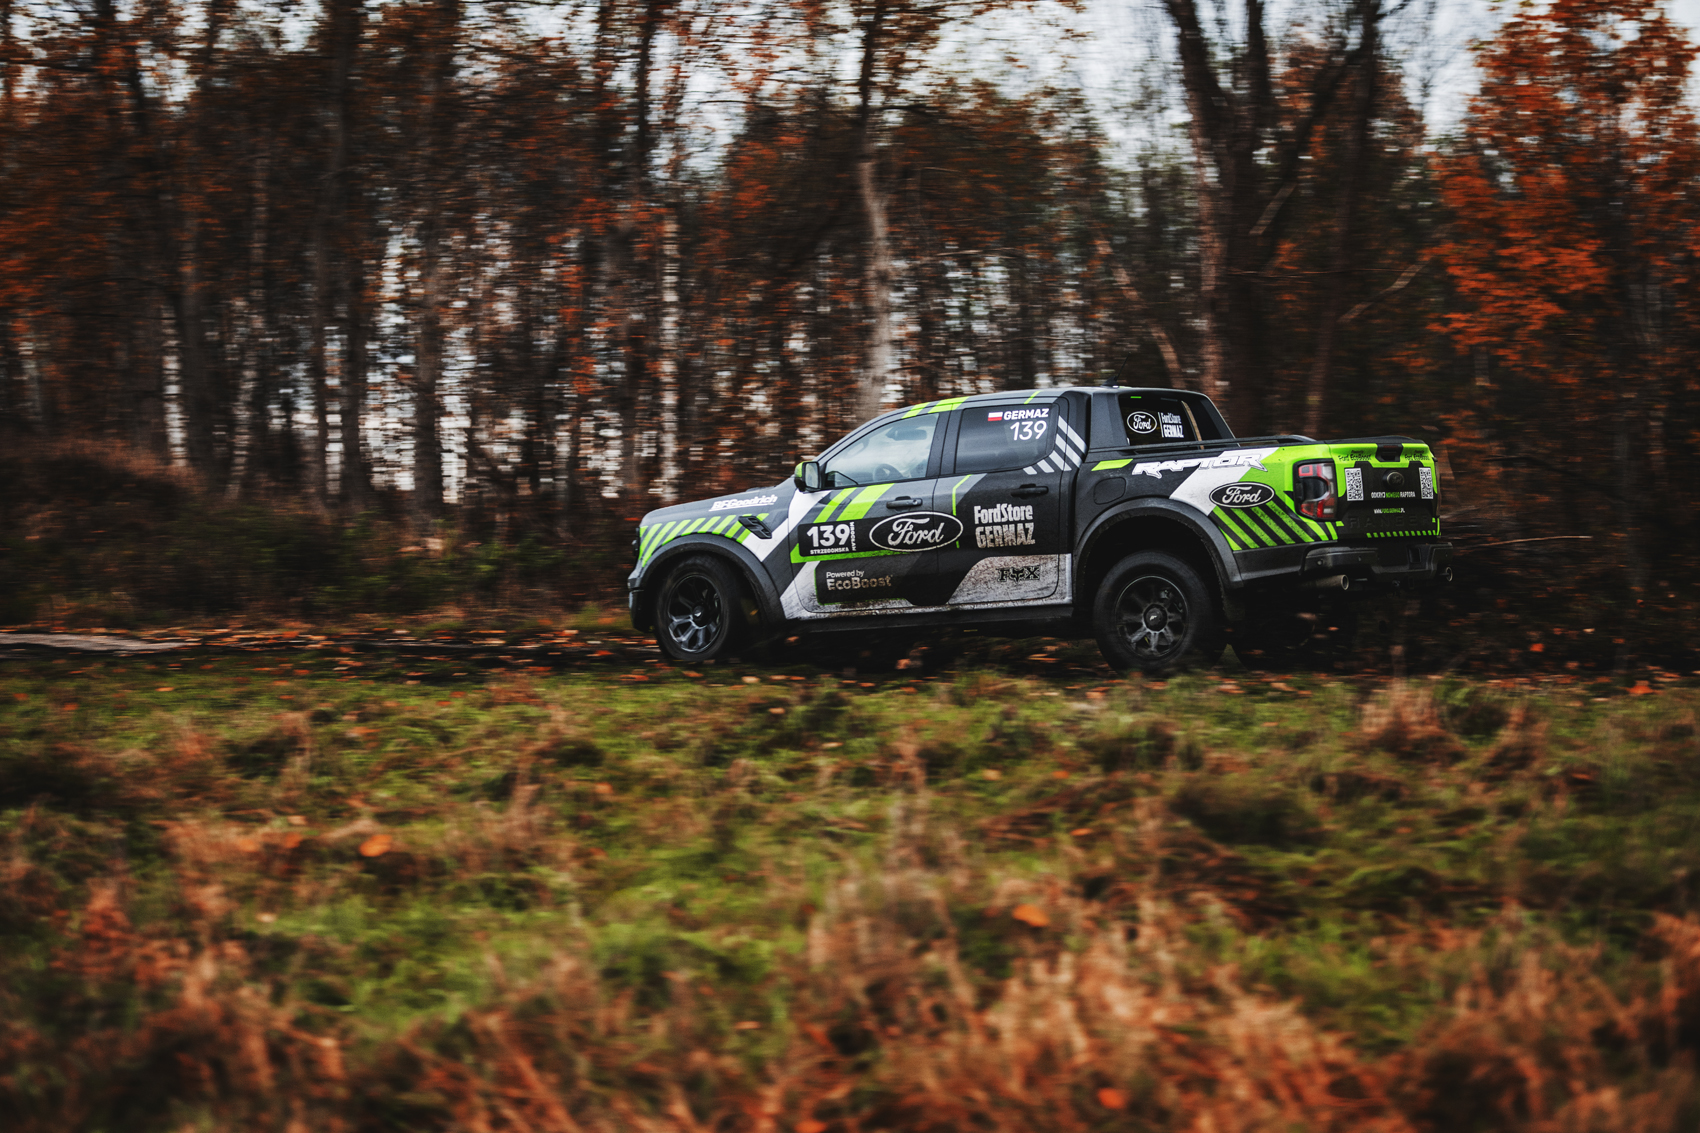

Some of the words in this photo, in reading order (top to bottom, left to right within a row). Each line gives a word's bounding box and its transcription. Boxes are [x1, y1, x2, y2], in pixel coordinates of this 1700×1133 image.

[1003, 408, 1050, 421] GERMAZ
[1133, 414, 1152, 430] Ford
[1010, 420, 1047, 441] 139
[1131, 454, 1268, 479] RAPTOR
[709, 494, 778, 511] BFGoodrich
[1222, 486, 1261, 503] Ford
[973, 503, 1034, 525] FordStore
[806, 523, 851, 548] 139
[887, 517, 945, 546] Ford
[975, 522, 1036, 549] GERMAZ
[825, 570, 855, 579] Powered
[856, 569, 865, 577] by
[826, 575, 892, 591] EcoBoost
